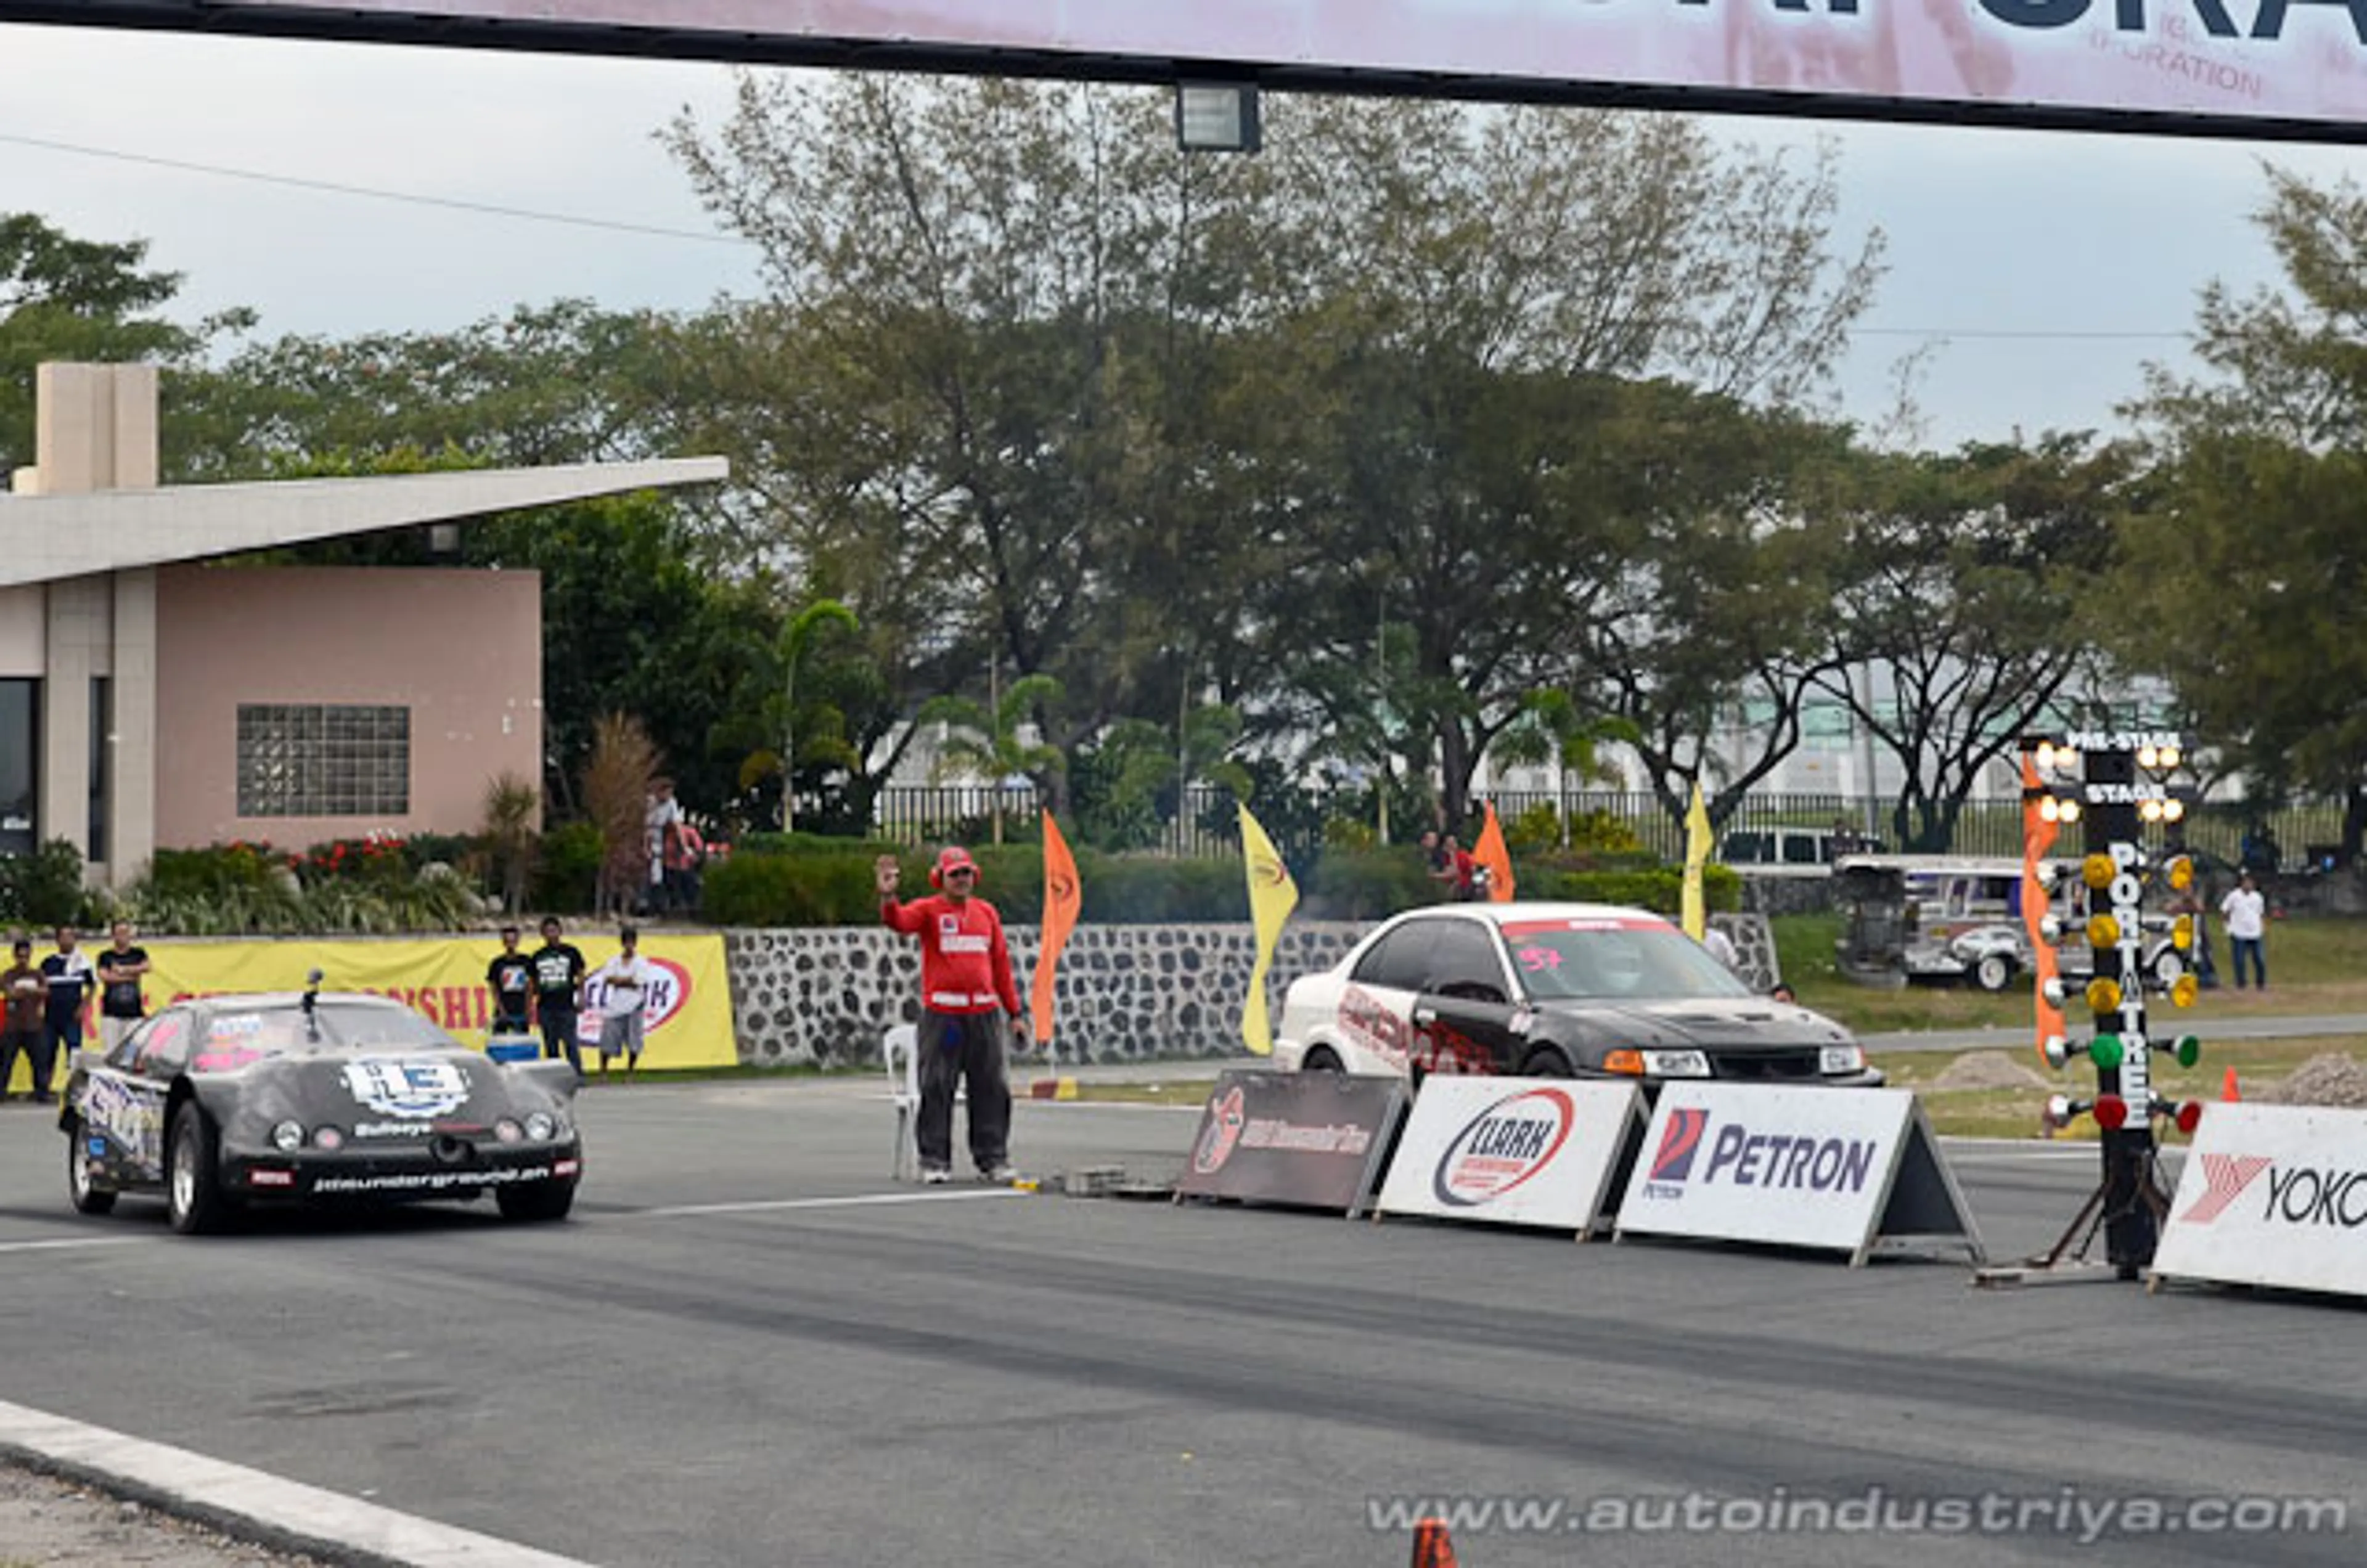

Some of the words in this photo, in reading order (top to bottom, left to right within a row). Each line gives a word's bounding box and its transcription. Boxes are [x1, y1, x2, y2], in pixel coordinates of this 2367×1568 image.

[2067, 732, 2182, 751] PRE-STAGE
[2085, 783, 2167, 804] STAGE
[1468, 1117, 1555, 1161] CLARK
[1703, 1124, 1876, 1193] PETRON
